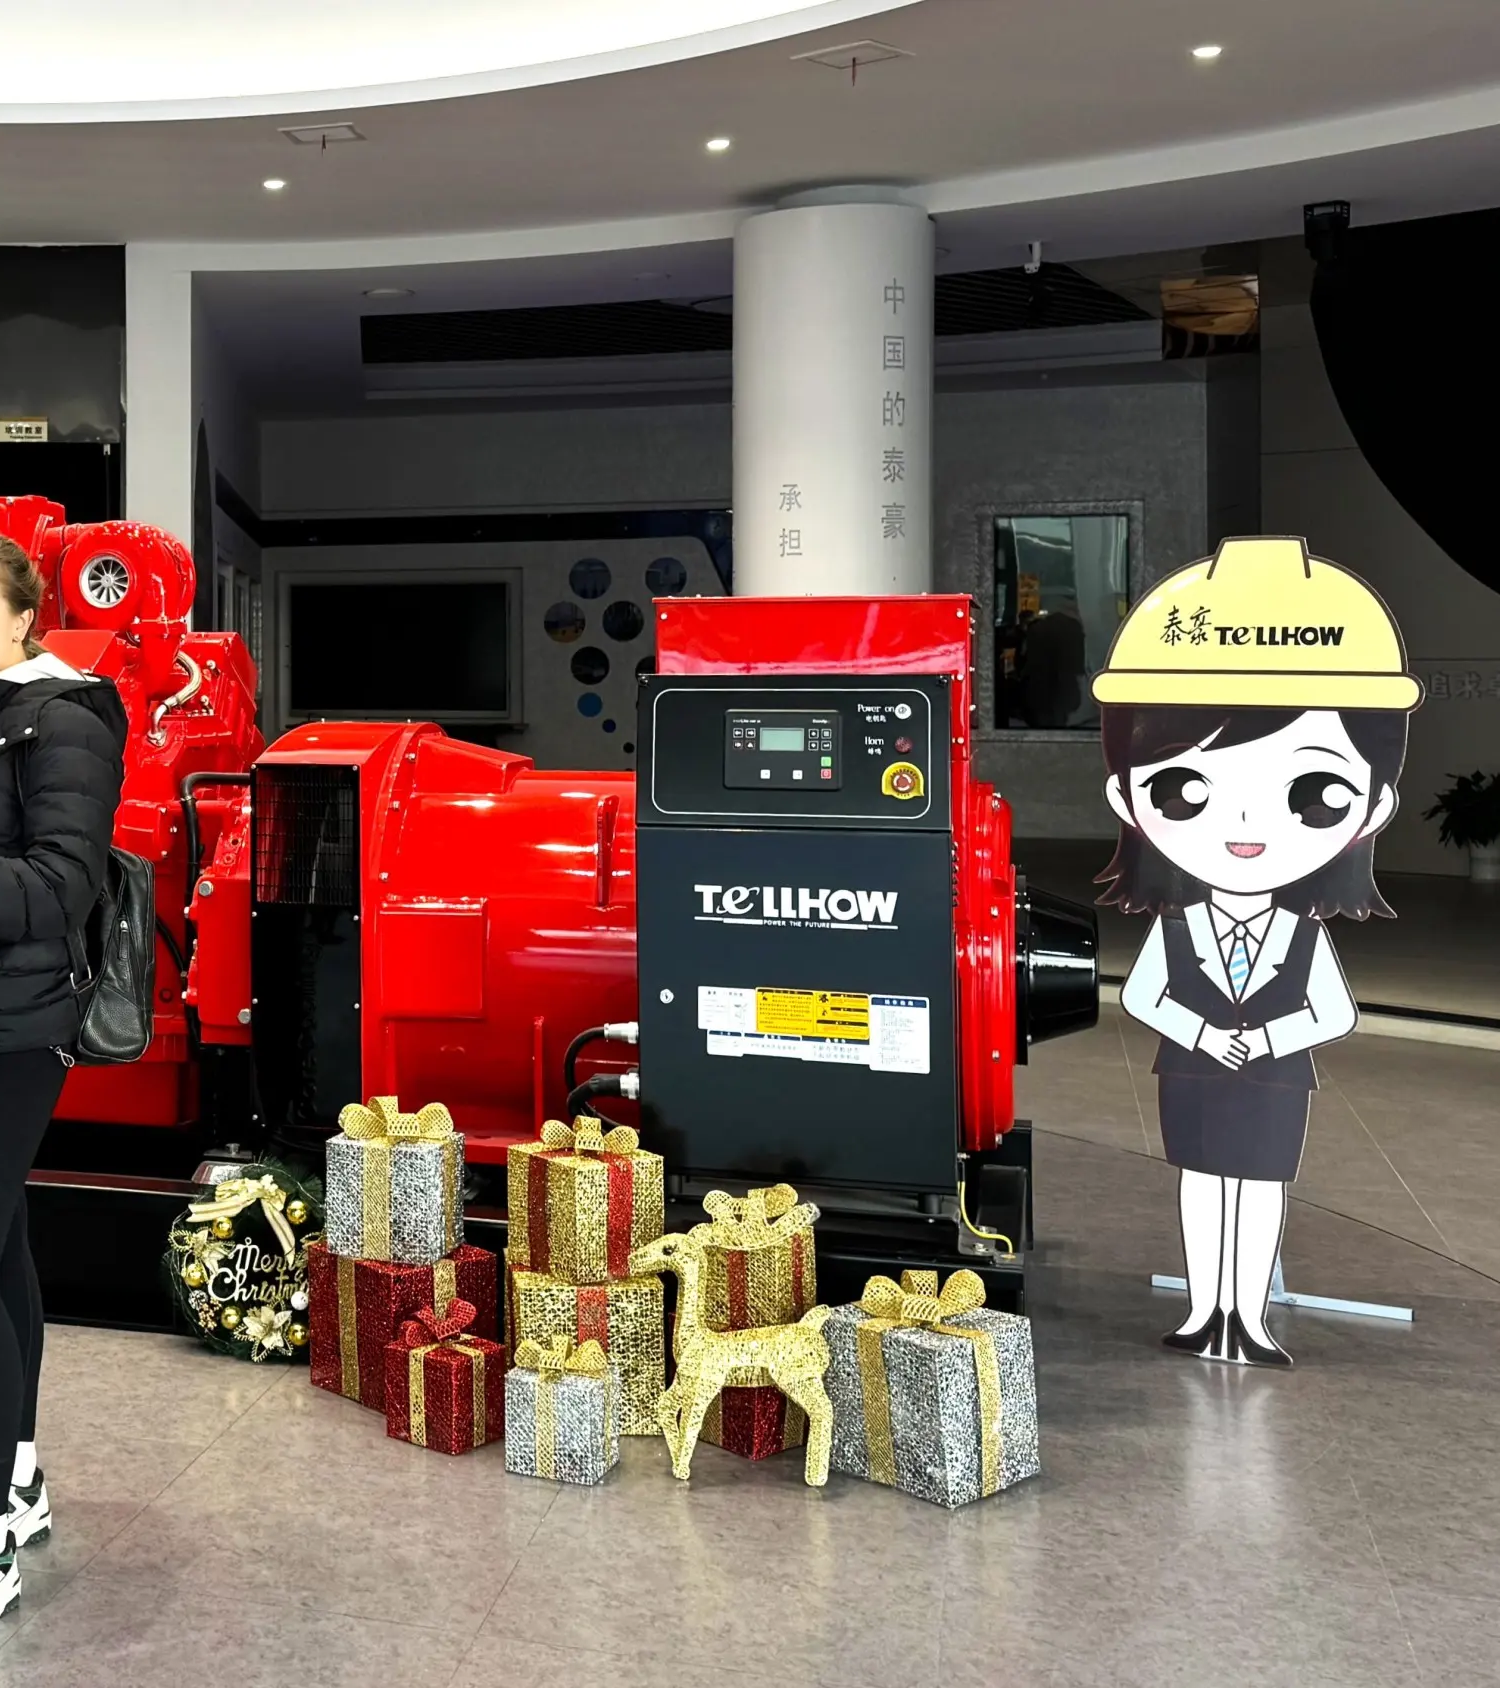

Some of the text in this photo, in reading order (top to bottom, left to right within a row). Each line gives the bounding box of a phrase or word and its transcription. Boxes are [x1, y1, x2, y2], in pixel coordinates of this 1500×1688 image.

[881, 277, 906, 539] 中国的泰豪
[778, 483, 803, 558] 承担
[1160, 605, 1212, 647] 泰豪
[857, 703, 881, 713] Power
[864, 736, 884, 746] Horn
[763, 919, 830, 929] POWER THE FUTURE
